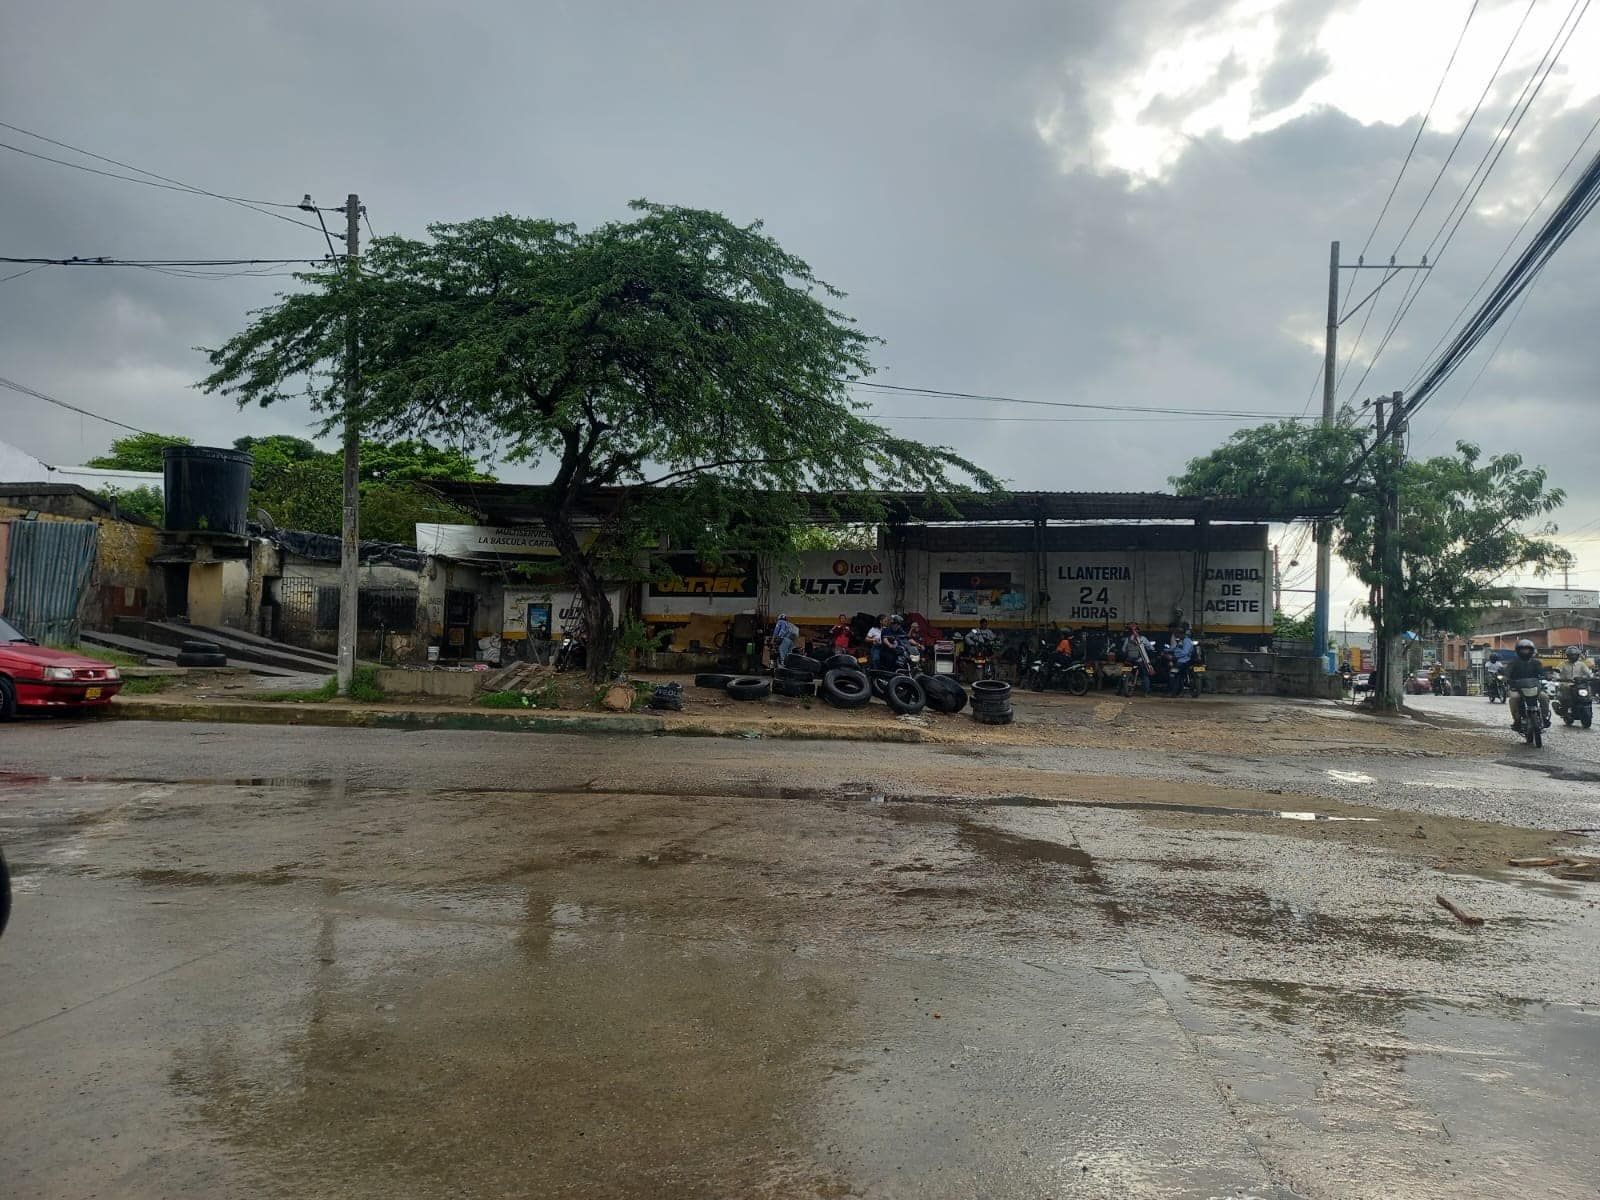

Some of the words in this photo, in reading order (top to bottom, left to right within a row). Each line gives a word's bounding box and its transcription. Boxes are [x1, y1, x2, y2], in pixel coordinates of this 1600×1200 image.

[478, 535, 490, 544] LA
[850, 562, 883, 576] terpel
[1058, 566, 1131, 580] LLANTERIA
[1205, 568, 1259, 581] CAMBIO
[788, 578, 882, 595] ULTREK
[1221, 584, 1242, 596] DE
[1079, 586, 1110, 605] 24
[1071, 606, 1118, 619] HORAS
[1204, 599, 1260, 613] ACEITE
